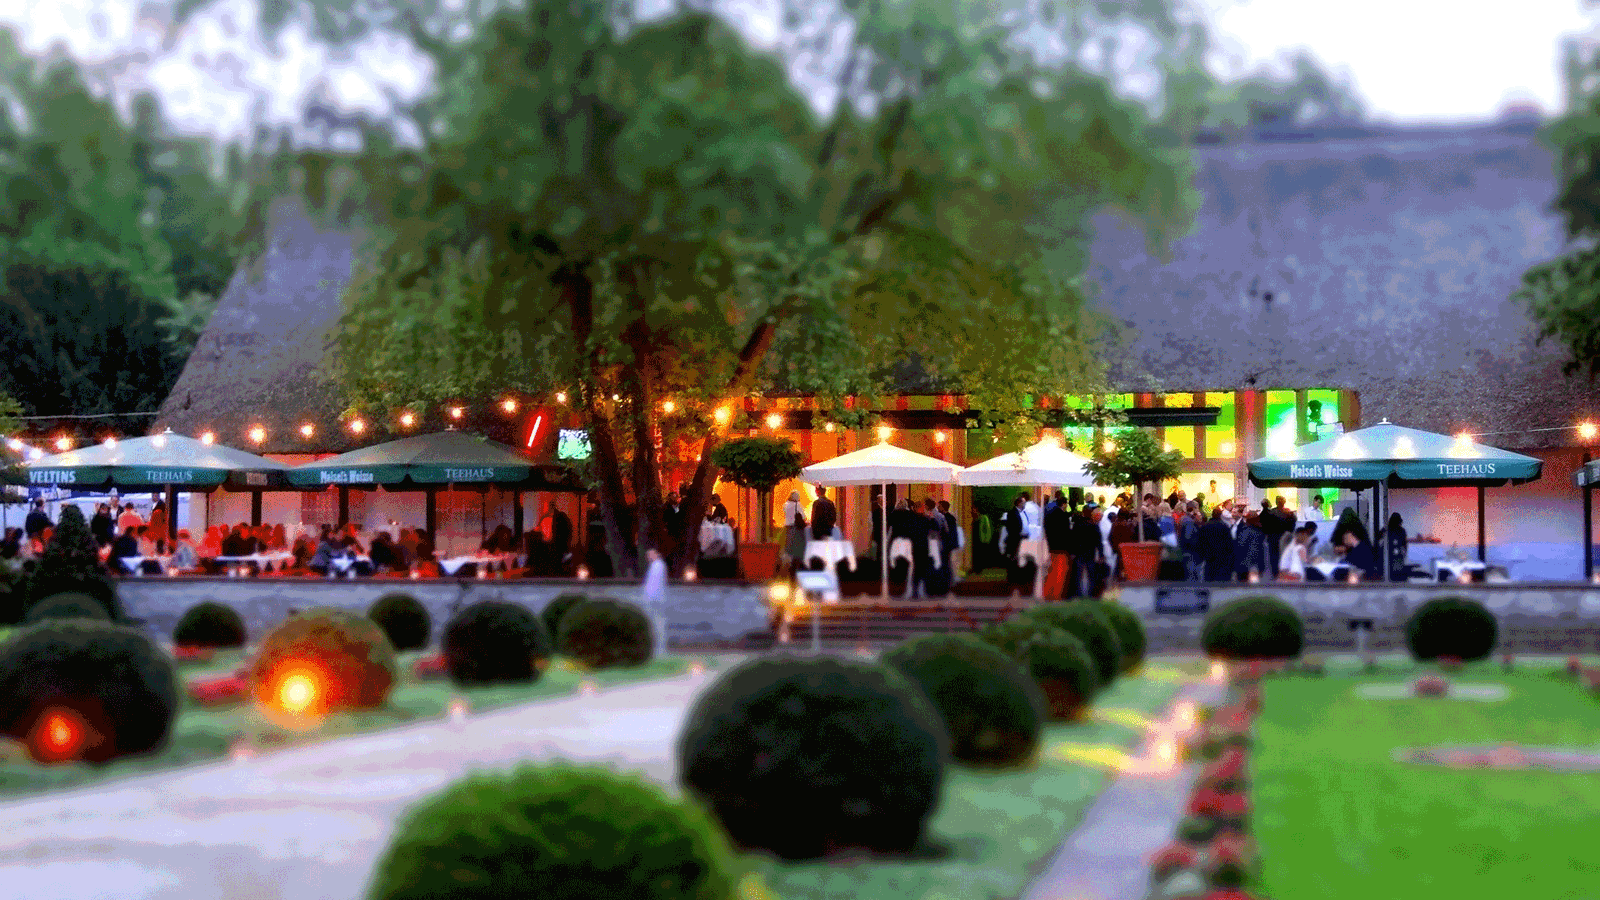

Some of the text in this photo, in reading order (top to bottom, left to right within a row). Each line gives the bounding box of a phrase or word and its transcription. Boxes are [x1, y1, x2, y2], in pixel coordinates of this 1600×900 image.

[444, 468, 494, 478] TEEHAUS
[1290, 464, 1353, 478] Maisel's Weisse
[1437, 463, 1495, 474] TEEHAUS
[29, 470, 76, 483] VELTINS
[146, 470, 193, 480] TEEHAUS
